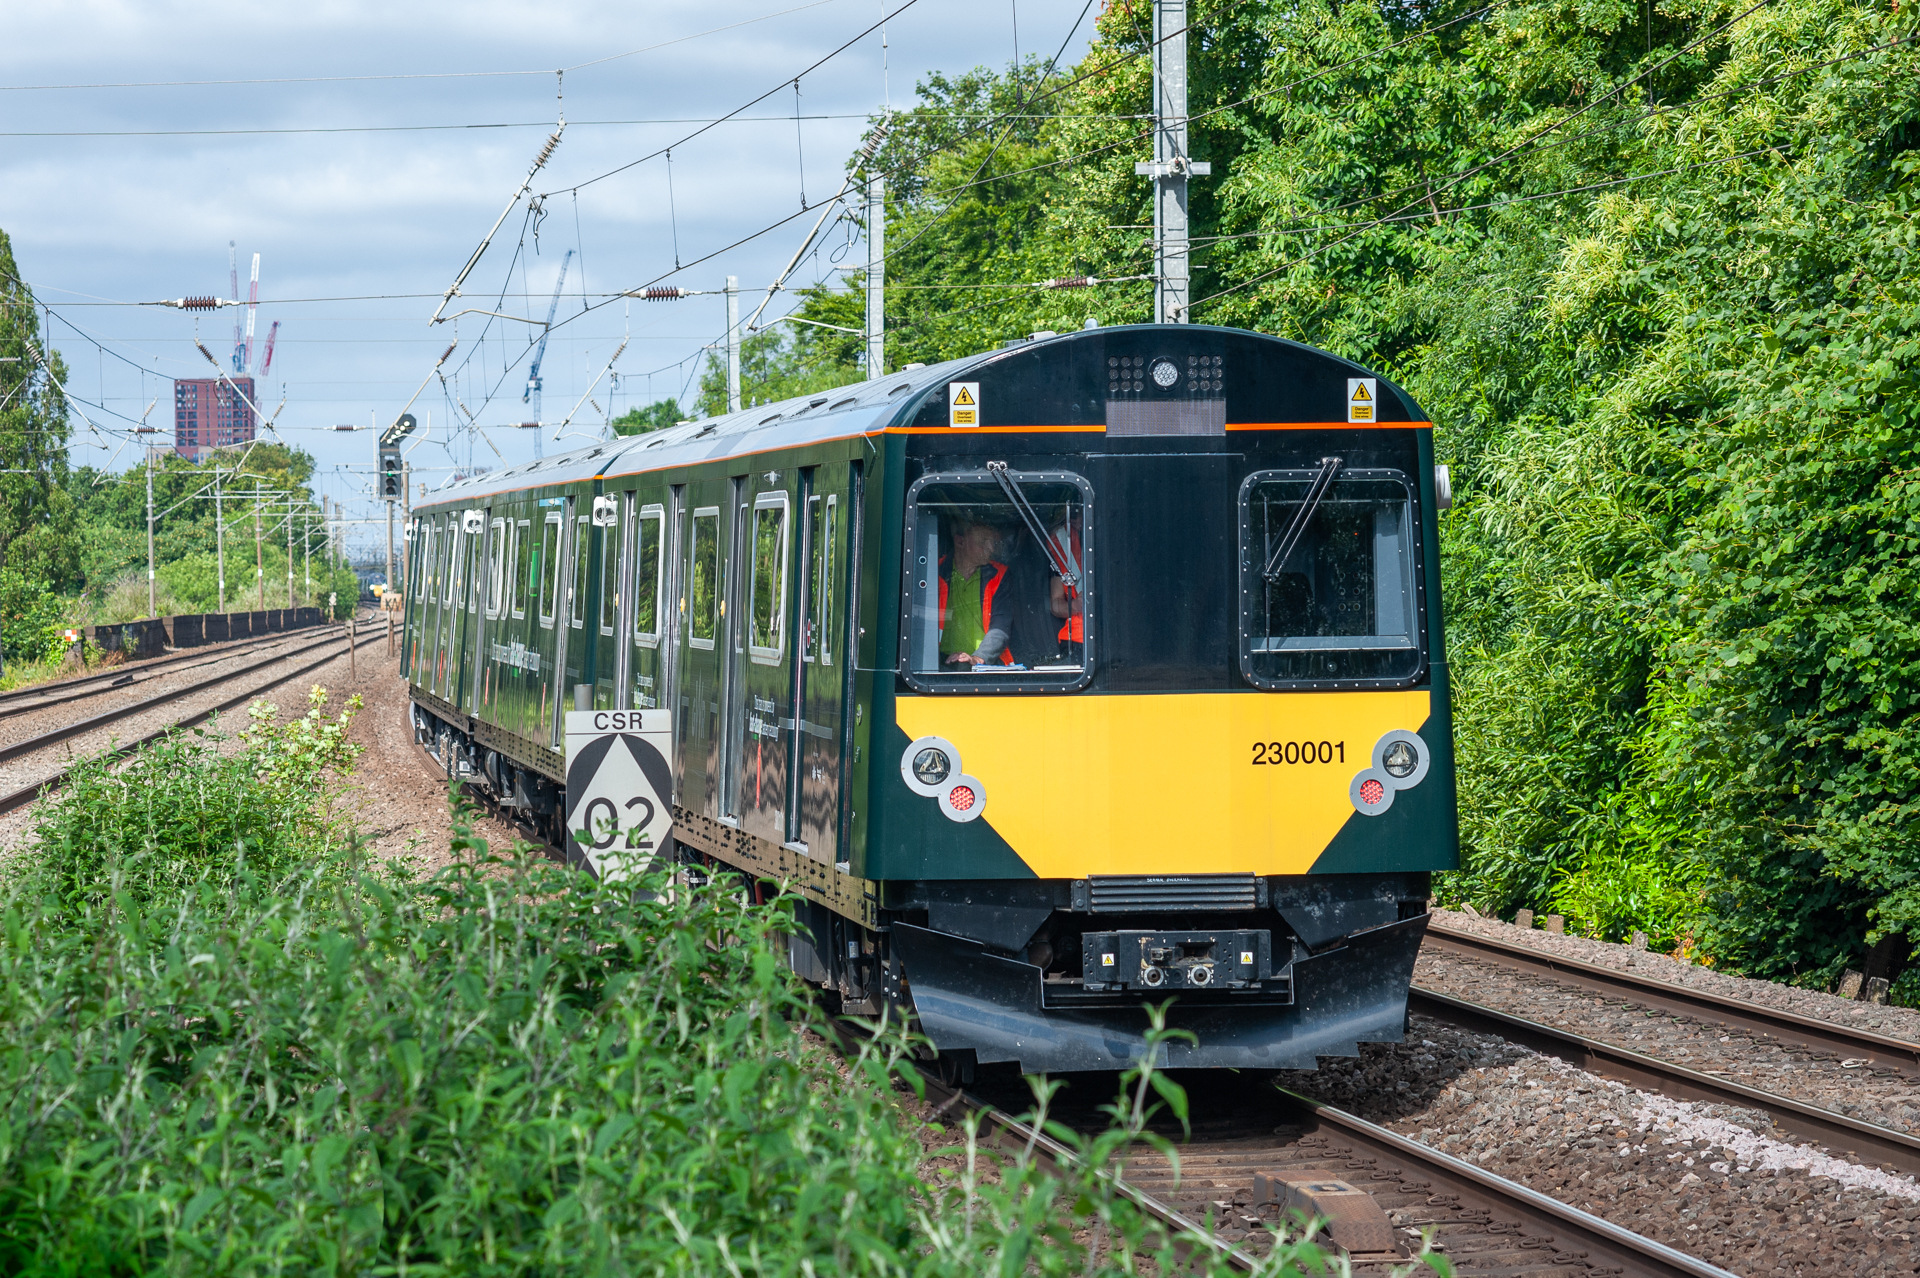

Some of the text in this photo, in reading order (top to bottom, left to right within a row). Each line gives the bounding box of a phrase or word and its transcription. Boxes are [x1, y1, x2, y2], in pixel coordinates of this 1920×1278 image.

[594, 712, 643, 730] CSR
[1252, 741, 1344, 765] 230001
[583, 796, 655, 850] 02
